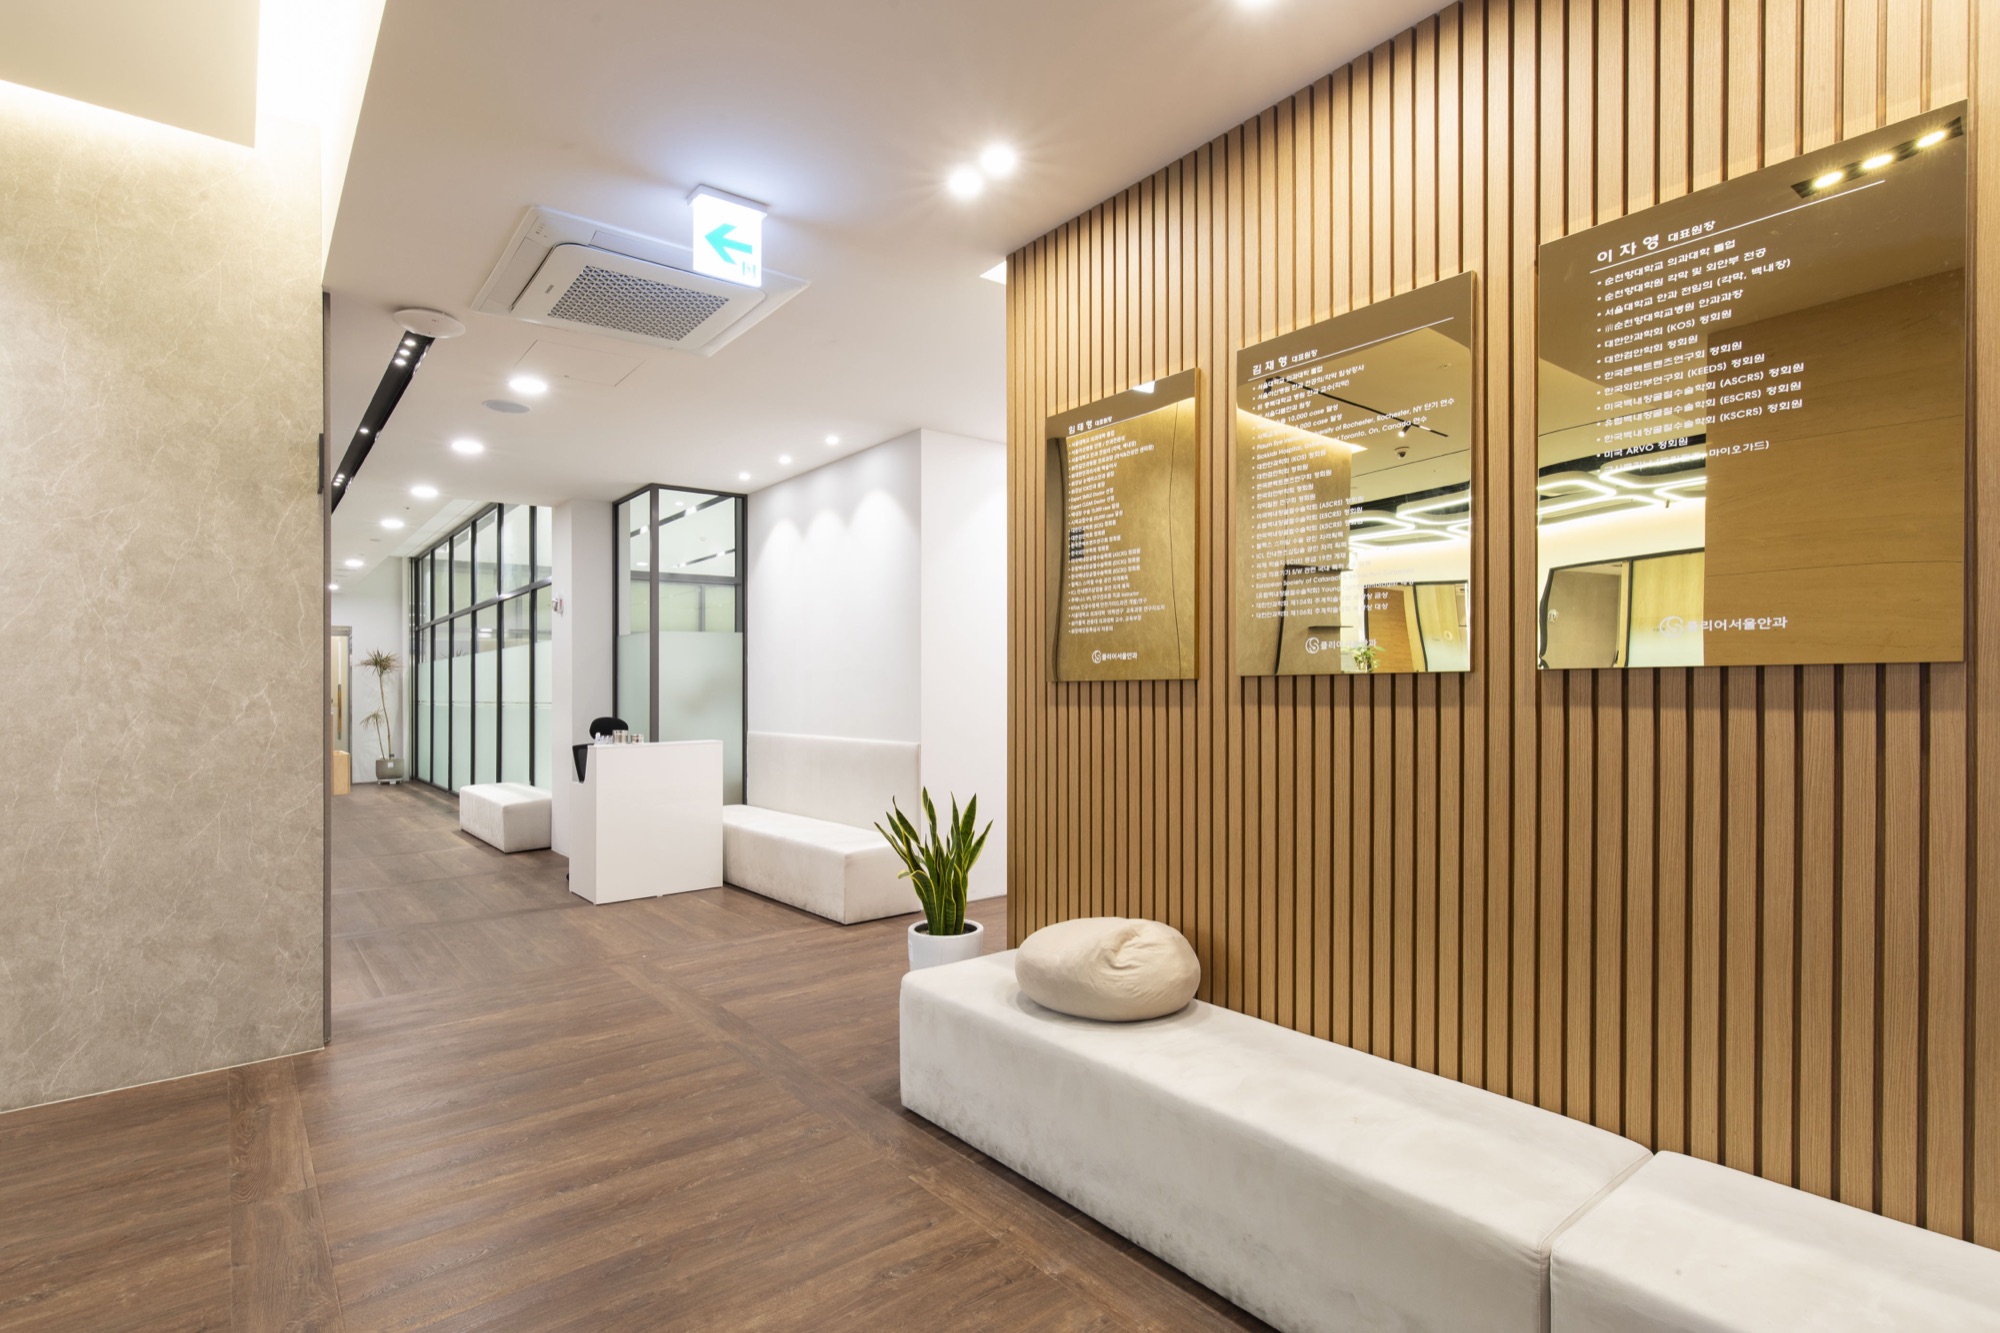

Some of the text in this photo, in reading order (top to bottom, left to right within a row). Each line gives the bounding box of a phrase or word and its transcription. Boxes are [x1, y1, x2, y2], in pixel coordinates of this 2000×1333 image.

[1668, 220, 1716, 244] 대표원장
[1605, 261, 1663, 286] 순천향대학교
[1668, 246, 1710, 267] 의과대학
[1605, 277, 1663, 302] 순천향대학원
[1668, 270, 1688, 284] 각막
[1706, 255, 1739, 273] 외안부
[1744, 247, 1766, 262] 전공
[1605, 258, 1791, 318] 서울대학교 안과 전임의 (각막, 백내장)
[1699, 288, 1743, 309] 안과과장
[1605, 309, 1732, 349] 대한안과학회 (KOS) 정회원
[1667, 334, 1698, 350] 정회원
[1710, 341, 1742, 357] 정회원
[1292, 348, 1317, 364] 대표원장
[1605, 353, 1765, 397] 한국외안부연구회 (KEEDS) 정회원
[1720, 371, 1764, 388] (ASCRS)
[1769, 362, 1804, 378] 정회원
[1720, 389, 1761, 406] (ESCRS)
[1766, 381, 1802, 397] 정회원
[1288, 412, 1307, 423] 10,000
[1309, 408, 1324, 417] case
[1343, 416, 1375, 430] Rochester,
[1413, 405, 1422, 413] NY
[1720, 406, 1763, 423] (KSCRS)
[1768, 398, 1803, 414] 정회원
[1313, 418, 1328, 427] case
[1342, 430, 1366, 441] Toronto,
[1604, 437, 1688, 460] 미국 ARVO 정회원
[1709, 440, 1769, 458] 마이오가드)
[1687, 616, 1788, 633] 리어서울안과
